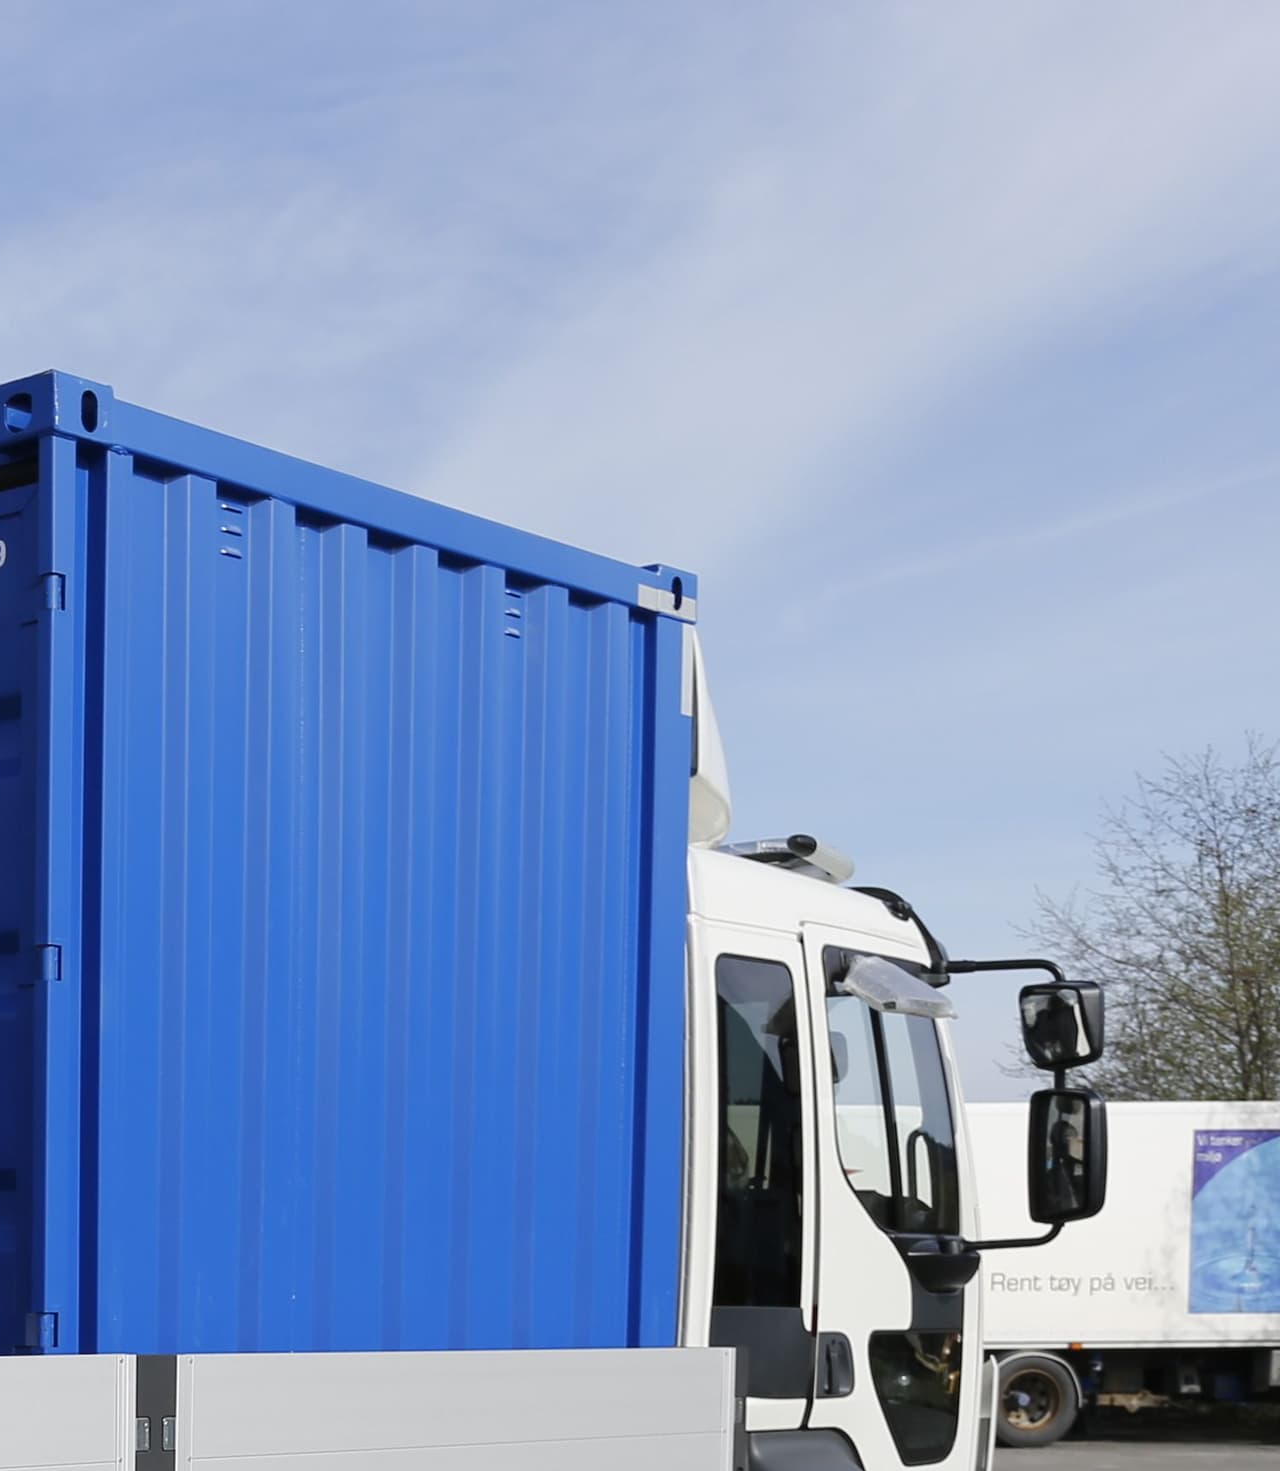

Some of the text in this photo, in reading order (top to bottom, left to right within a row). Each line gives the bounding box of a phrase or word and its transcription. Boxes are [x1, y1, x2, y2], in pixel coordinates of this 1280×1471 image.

[990, 1272, 1042, 1292] Rent
[1049, 1273, 1081, 1297] tøy
[1089, 1273, 1115, 1296] på
